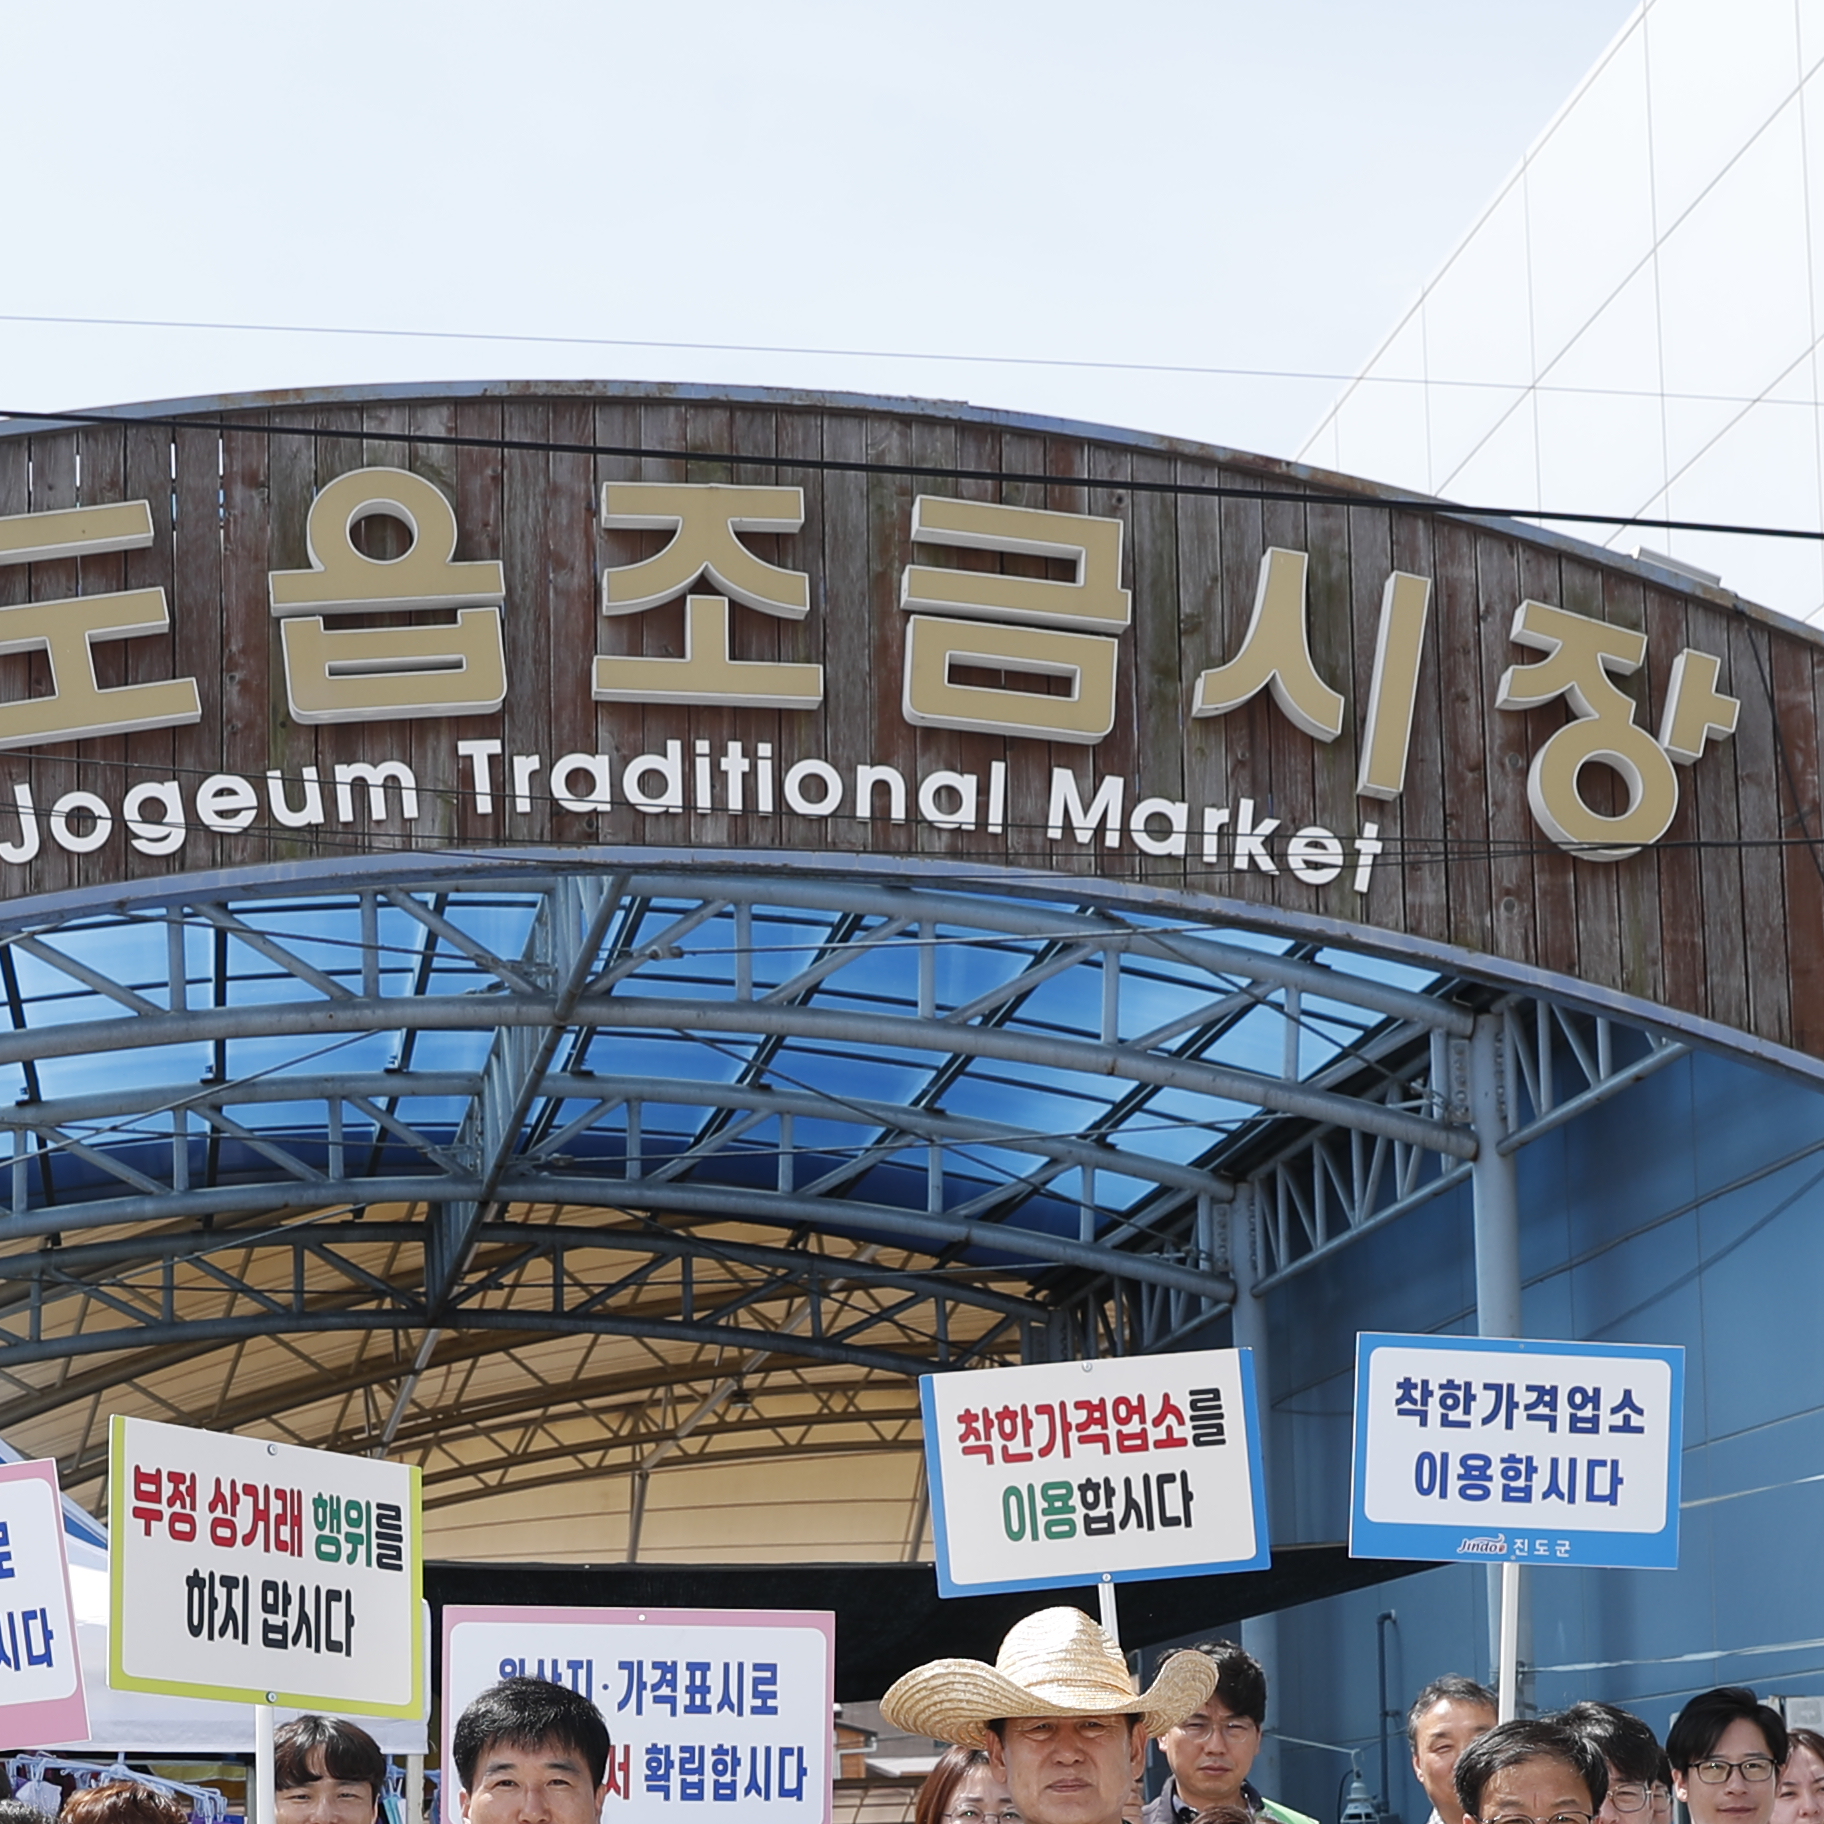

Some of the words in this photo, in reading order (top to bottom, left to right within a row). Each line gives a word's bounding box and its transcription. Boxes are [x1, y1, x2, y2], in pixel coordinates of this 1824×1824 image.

[457, 738, 1005, 834] Traditional
[1047, 768, 1384, 894] Market
[956, 1386, 1227, 1467] 착한가격업소를
[1394, 1376, 1646, 1436] 착한가격업소
[1003, 1470, 1195, 1543] 이용합시다
[1414, 1452, 1623, 1507] 이용합시다
[131, 1463, 198, 1543] 부정
[207, 1481, 304, 1558] 상거래
[312, 1490, 405, 1573] 행위를
[1457, 1539, 1498, 1554] Jindo
[1512, 1538, 1572, 1558] 진도군
[185, 1568, 250, 1647] 하지
[261, 1581, 356, 1659] 맙시다
[644, 1743, 808, 1802] 확립합시다
